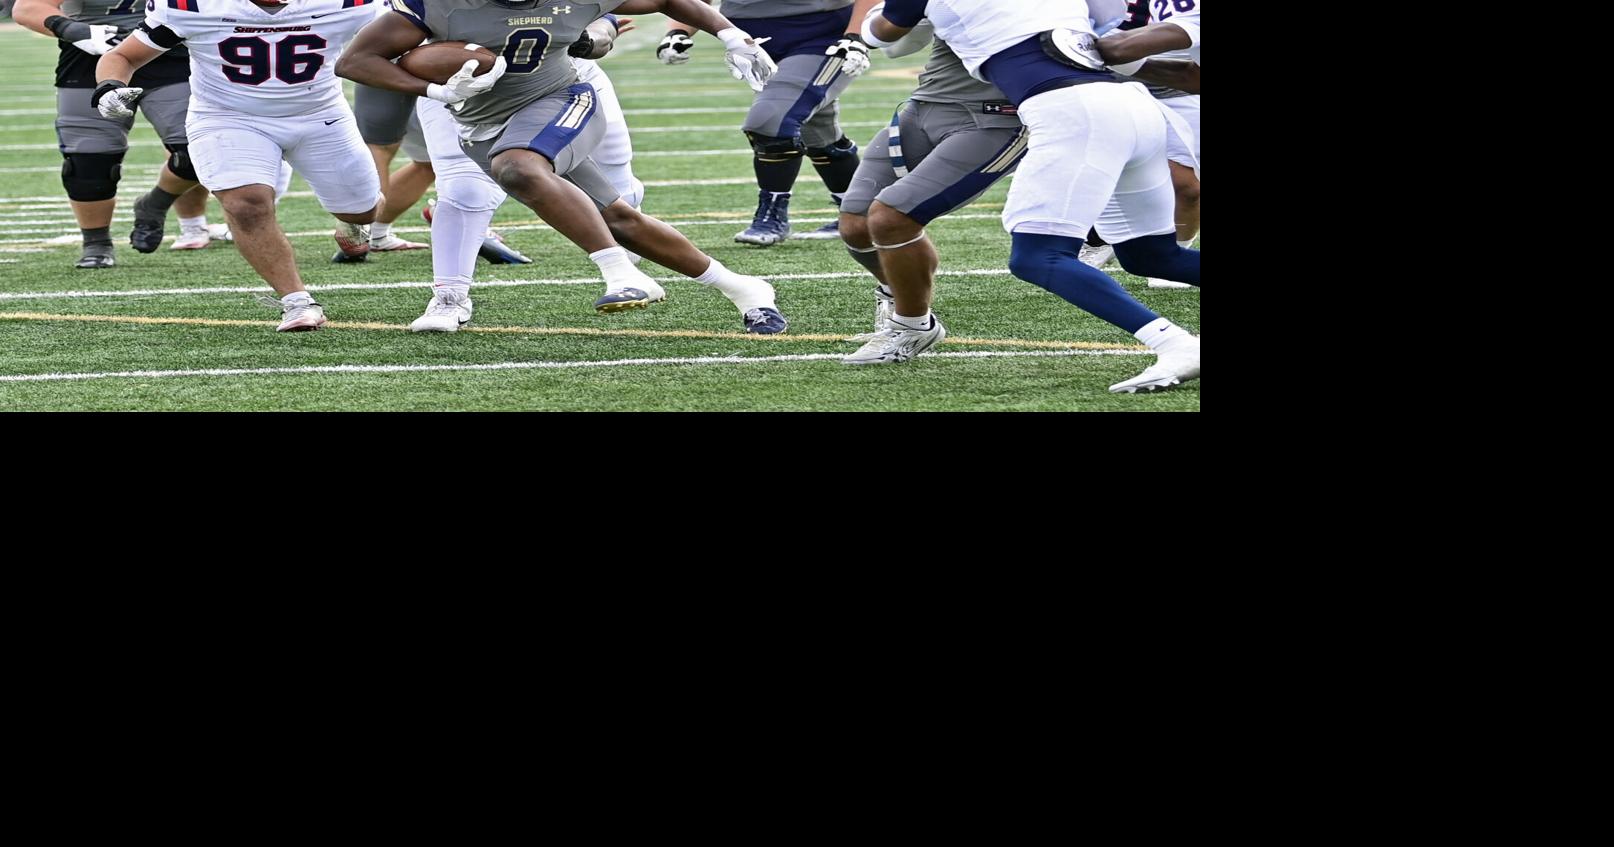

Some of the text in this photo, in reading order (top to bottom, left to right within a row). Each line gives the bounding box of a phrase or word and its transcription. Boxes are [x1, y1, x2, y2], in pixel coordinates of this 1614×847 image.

[507, 16, 553, 26] SHEPHERD
[217, 33, 328, 86] 96
[500, 27, 552, 75] 0
